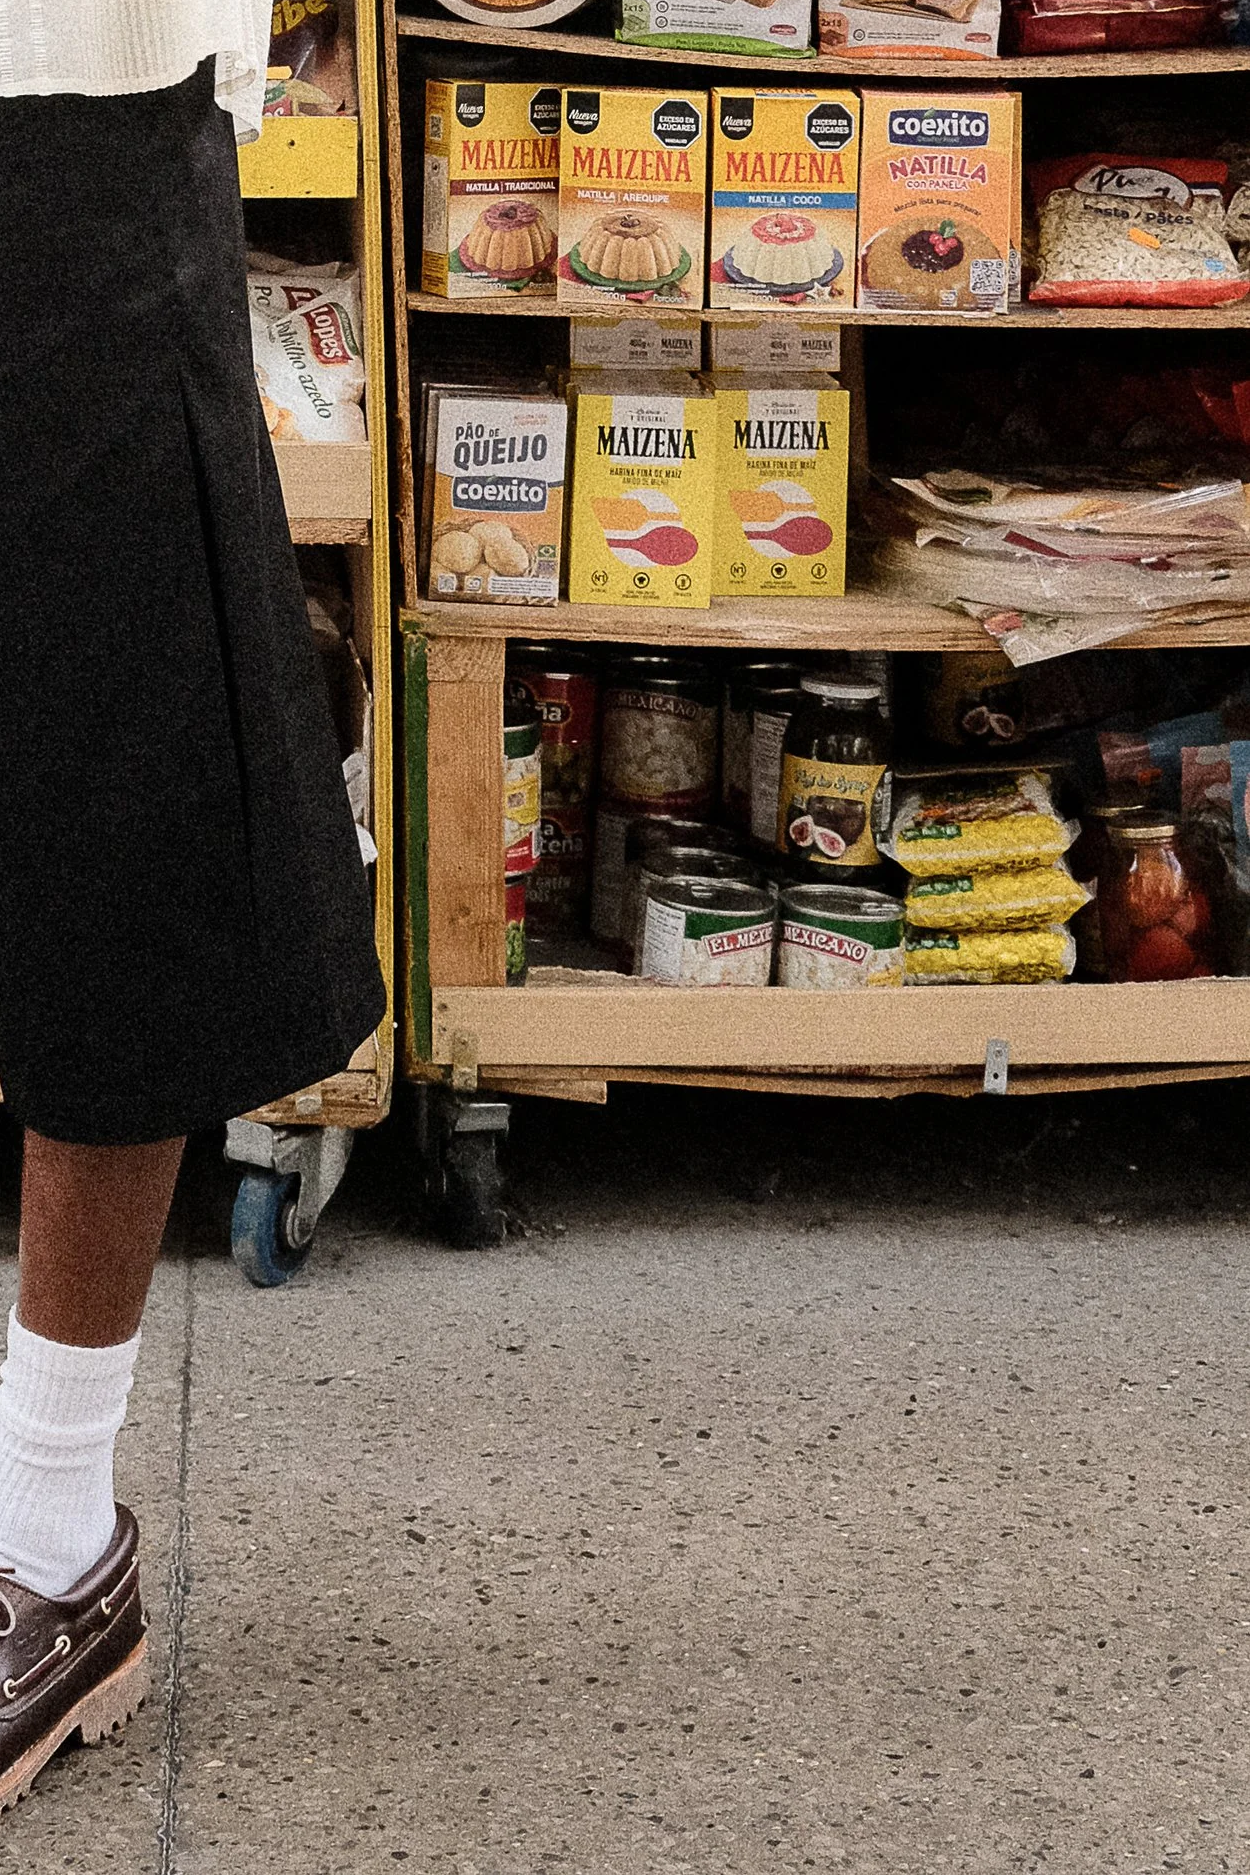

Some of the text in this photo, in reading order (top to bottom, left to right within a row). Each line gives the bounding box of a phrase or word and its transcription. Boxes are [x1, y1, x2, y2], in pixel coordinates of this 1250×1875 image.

[570, 109, 598, 121] Nueva
[656, 116, 681, 124] EXCESO
[461, 138, 560, 171] MAIZENA
[572, 146, 692, 182] MAIZENA
[726, 151, 845, 184] MAIZENA
[889, 155, 988, 184] NATILLA
[466, 181, 556, 192] NATILLA TRADICIONAL
[578, 189, 669, 203] NATILLA AREQUIPE
[906, 179, 968, 190] con PANELA
[749, 195, 821, 204] NATILLA COCO
[894, 202, 917, 215] Mezcla
[918, 199, 934, 209] lista
[936, 199, 951, 208] para
[1083, 204, 1194, 225] Pasta Pâtes
[311, 307, 341, 358] Lopes
[300, 375, 334, 419] azedo
[455, 422, 500, 440] PÃO DE
[596, 425, 696, 460] MAIZENA
[733, 419, 830, 451] MAIZENA
[453, 434, 548, 468] QUEIJO
[609, 467, 632, 477] HARINA
[635, 468, 651, 477] FINA
[653, 469, 663, 478] DE
[709, 926, 772, 954] EL MEXI
[783, 924, 868, 962] MEXICANO
